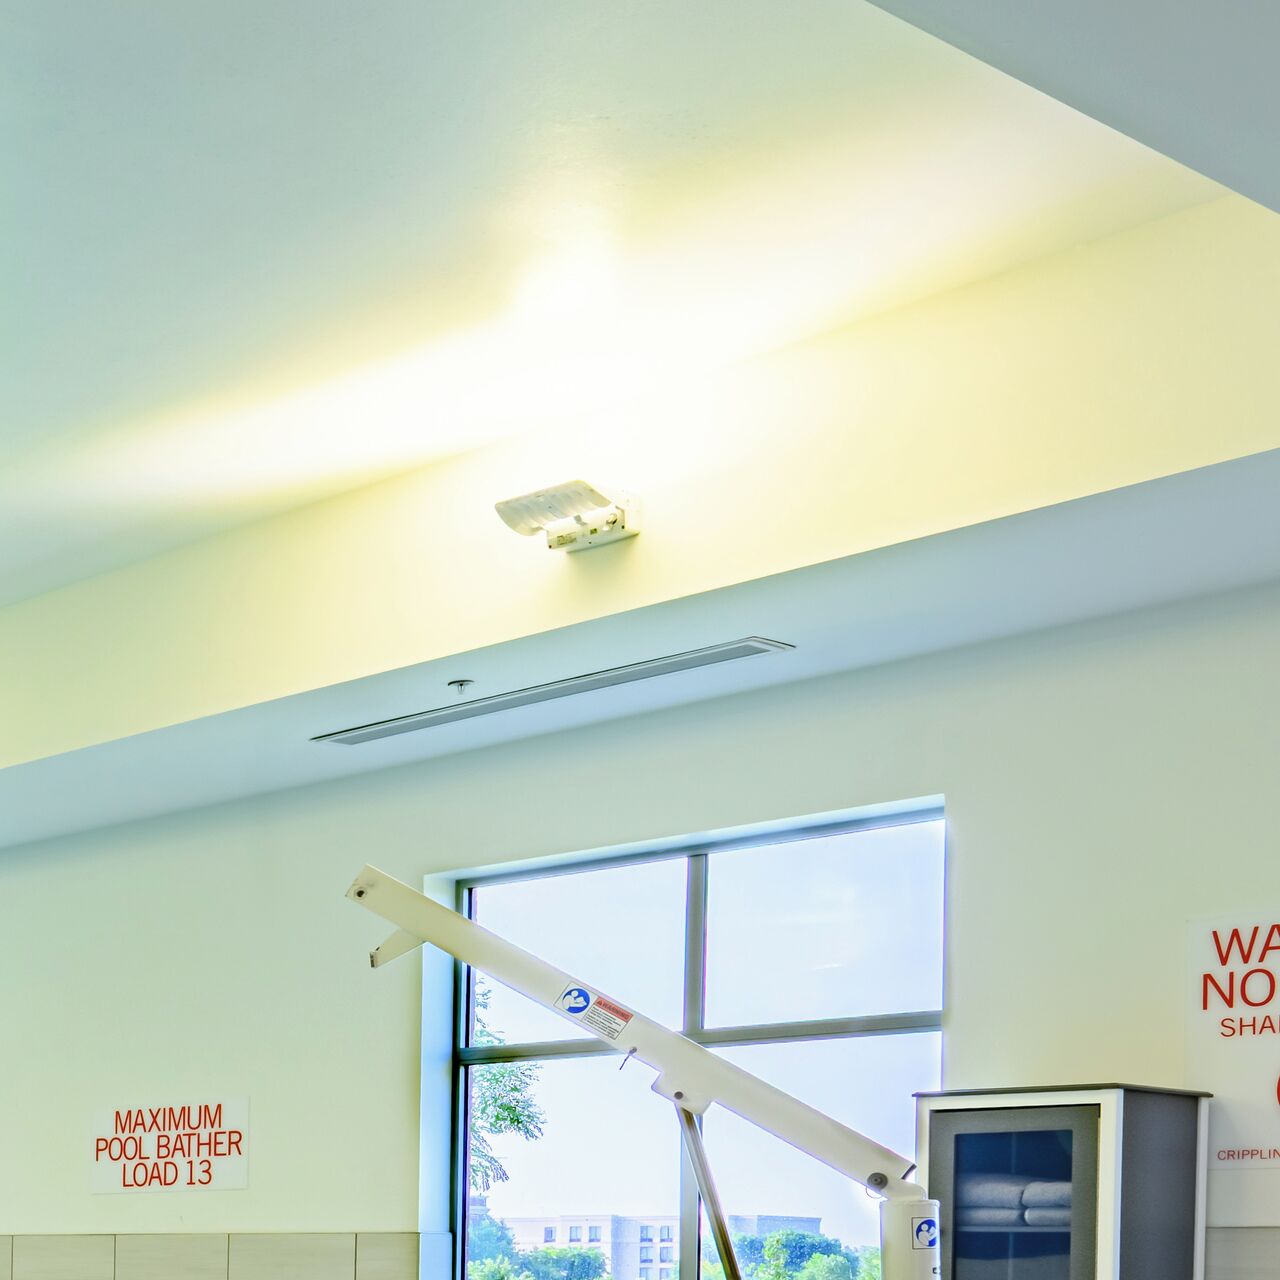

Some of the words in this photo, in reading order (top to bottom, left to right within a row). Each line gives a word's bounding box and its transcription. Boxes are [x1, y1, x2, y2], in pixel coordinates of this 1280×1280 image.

[1203, 968, 1277, 1011] NO
[1220, 1015, 1280, 1038] SHA
[114, 1103, 222, 1134] MAXIMUM
[96, 1136, 150, 1162] POOL
[157, 1130, 242, 1159] BATHER
[122, 1161, 178, 1187] LOAD
[186, 1159, 212, 1185] 13
